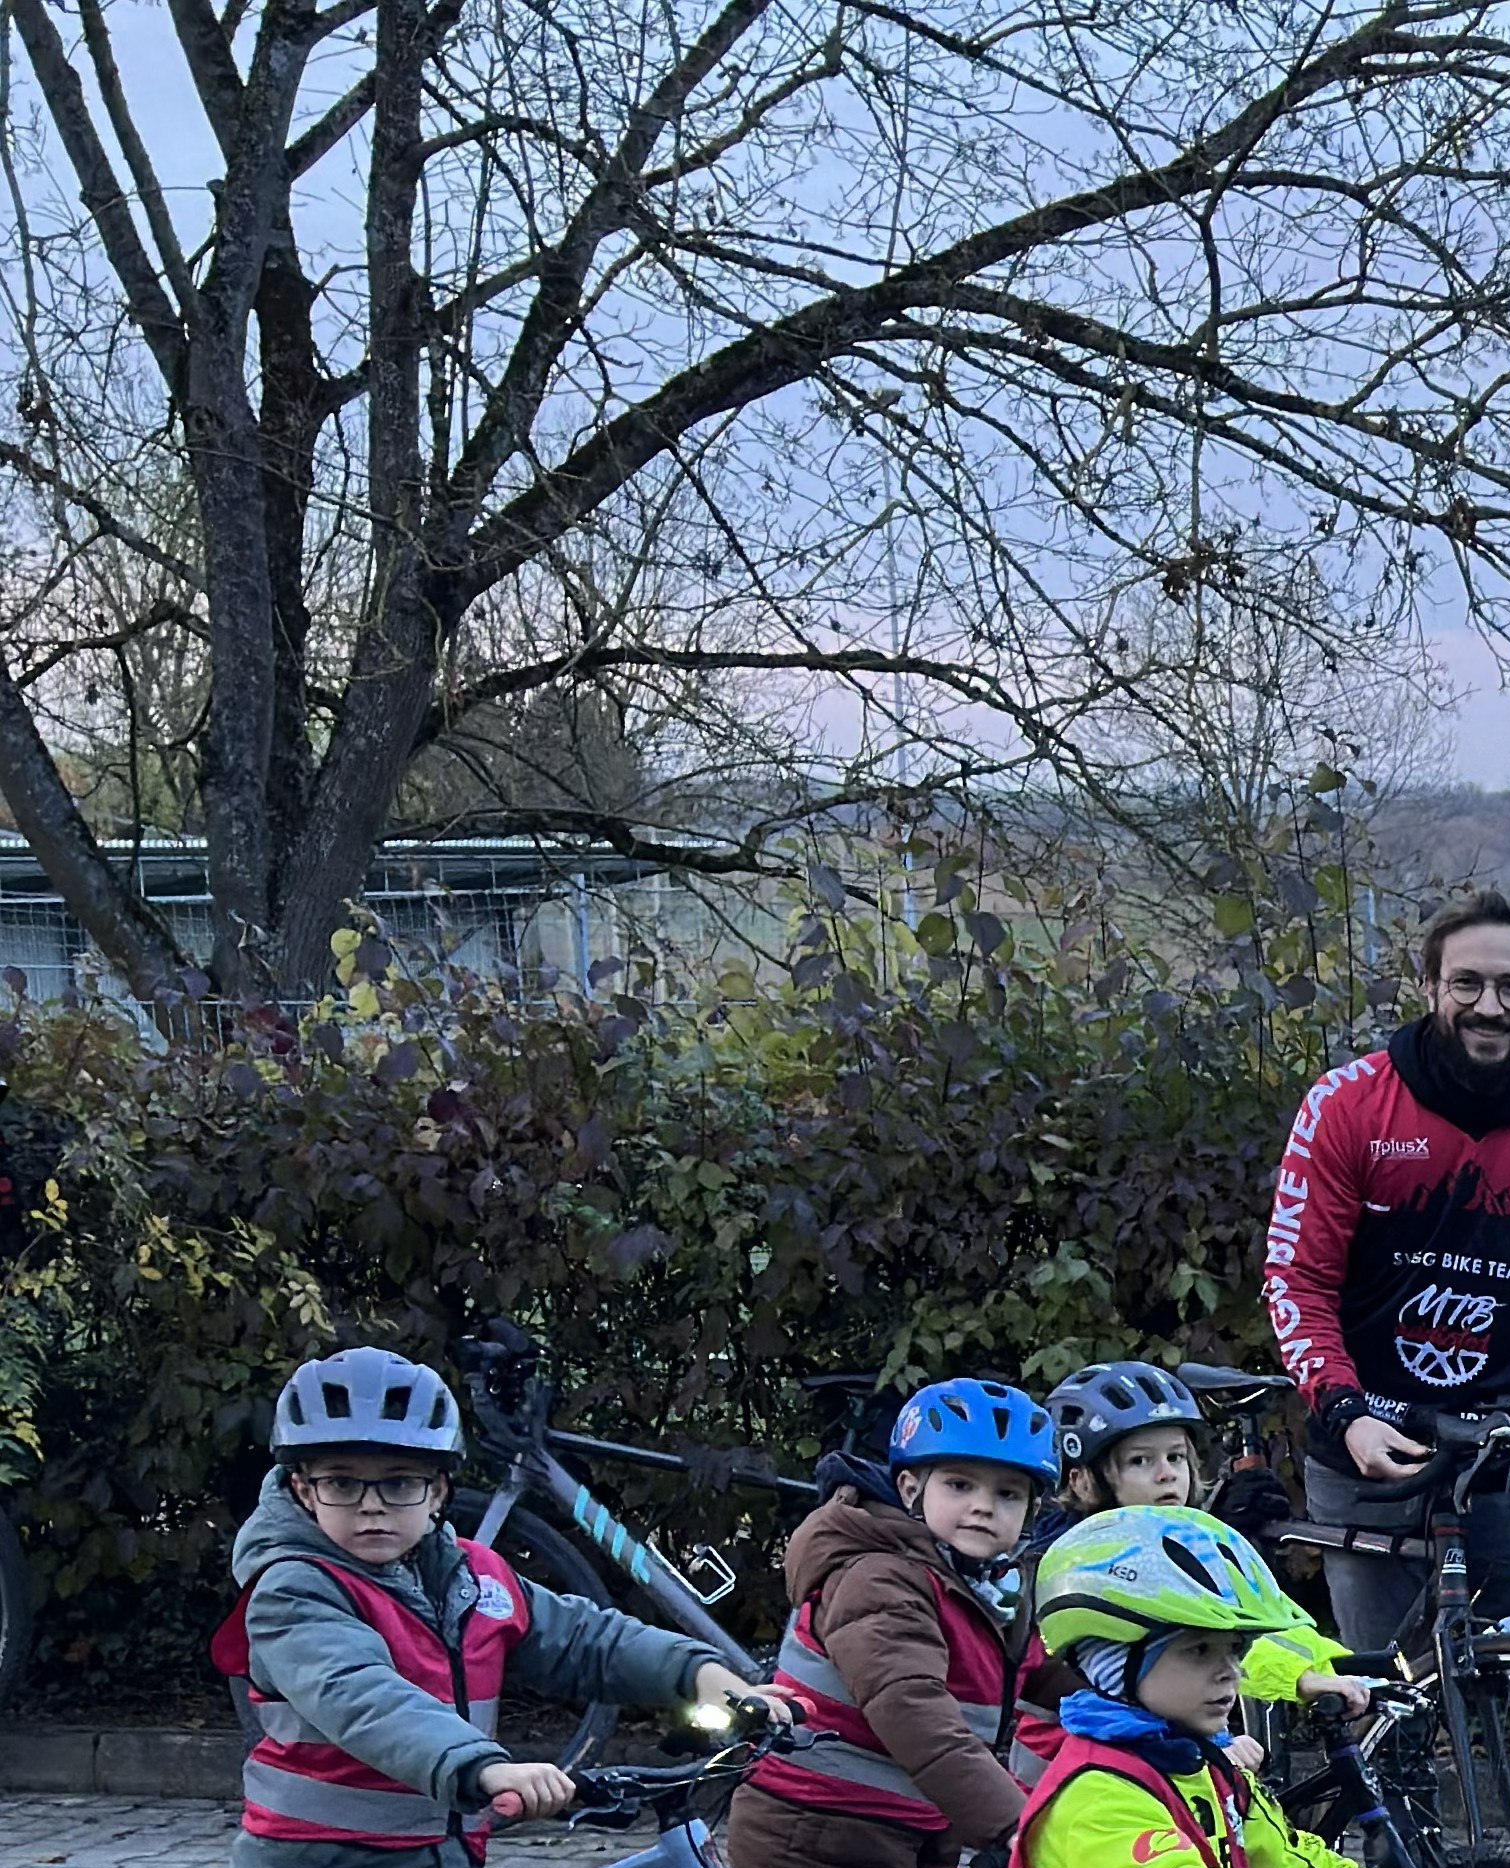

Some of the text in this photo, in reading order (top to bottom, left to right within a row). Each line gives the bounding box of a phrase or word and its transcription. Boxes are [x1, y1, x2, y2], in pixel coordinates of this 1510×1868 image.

[1285, 1057, 1377, 1160] TEAM
[1264, 1167, 1310, 1267] BIKE
[1441, 1252, 1483, 1275] BIKE
[1399, 1283, 1508, 1333] MTB
